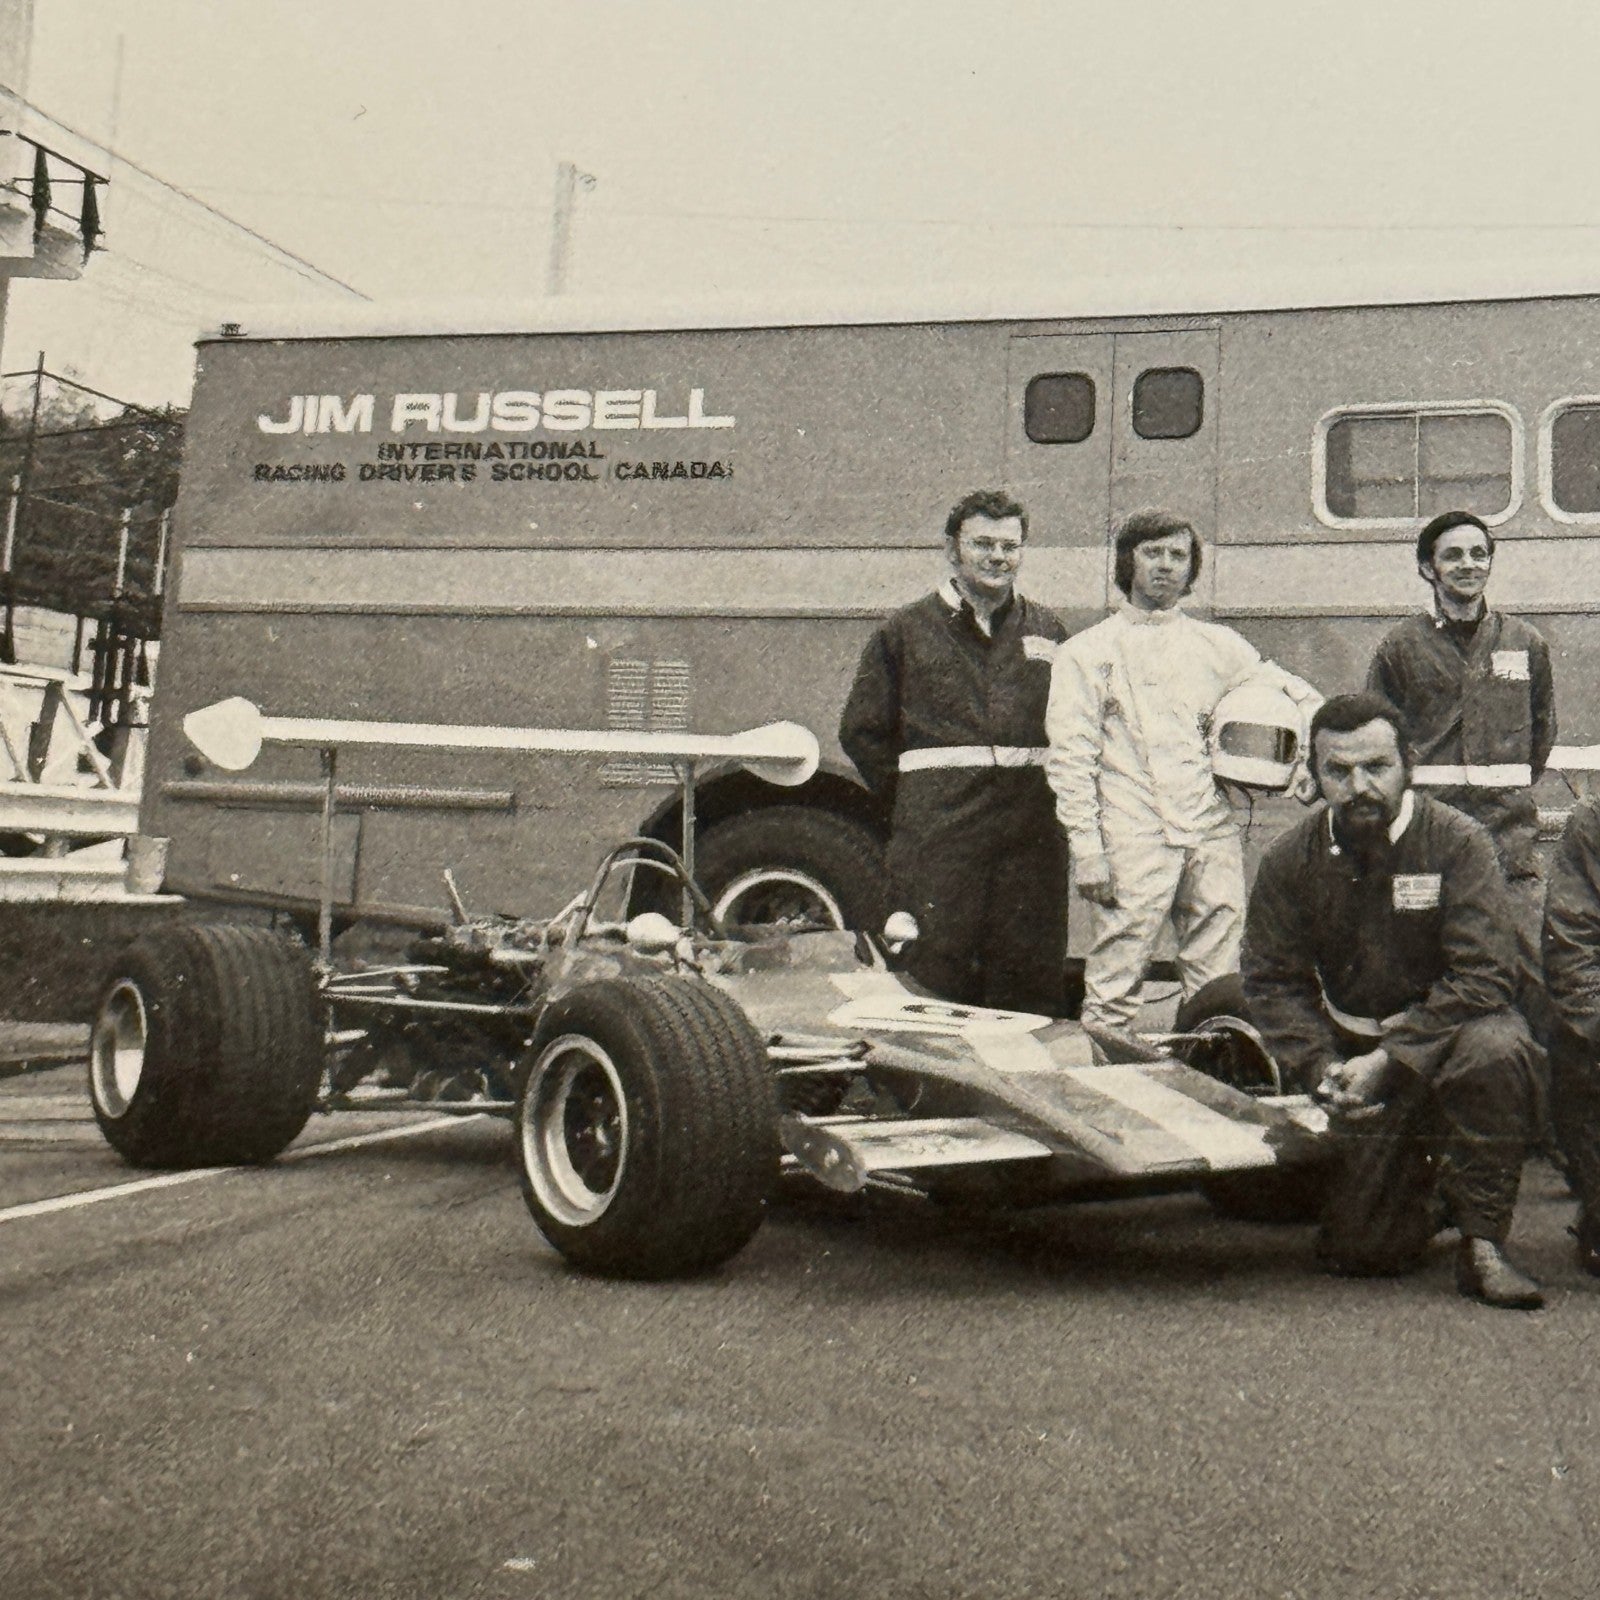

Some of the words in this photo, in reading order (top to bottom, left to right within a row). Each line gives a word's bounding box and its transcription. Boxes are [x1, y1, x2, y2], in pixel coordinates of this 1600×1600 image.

[258, 394, 375, 434] JIM
[391, 388, 735, 433] RUSSELL
[378, 441, 604, 461] INTERNATIONAL
[254, 463, 346, 482] RACING
[491, 461, 600, 481] SCHOOL
